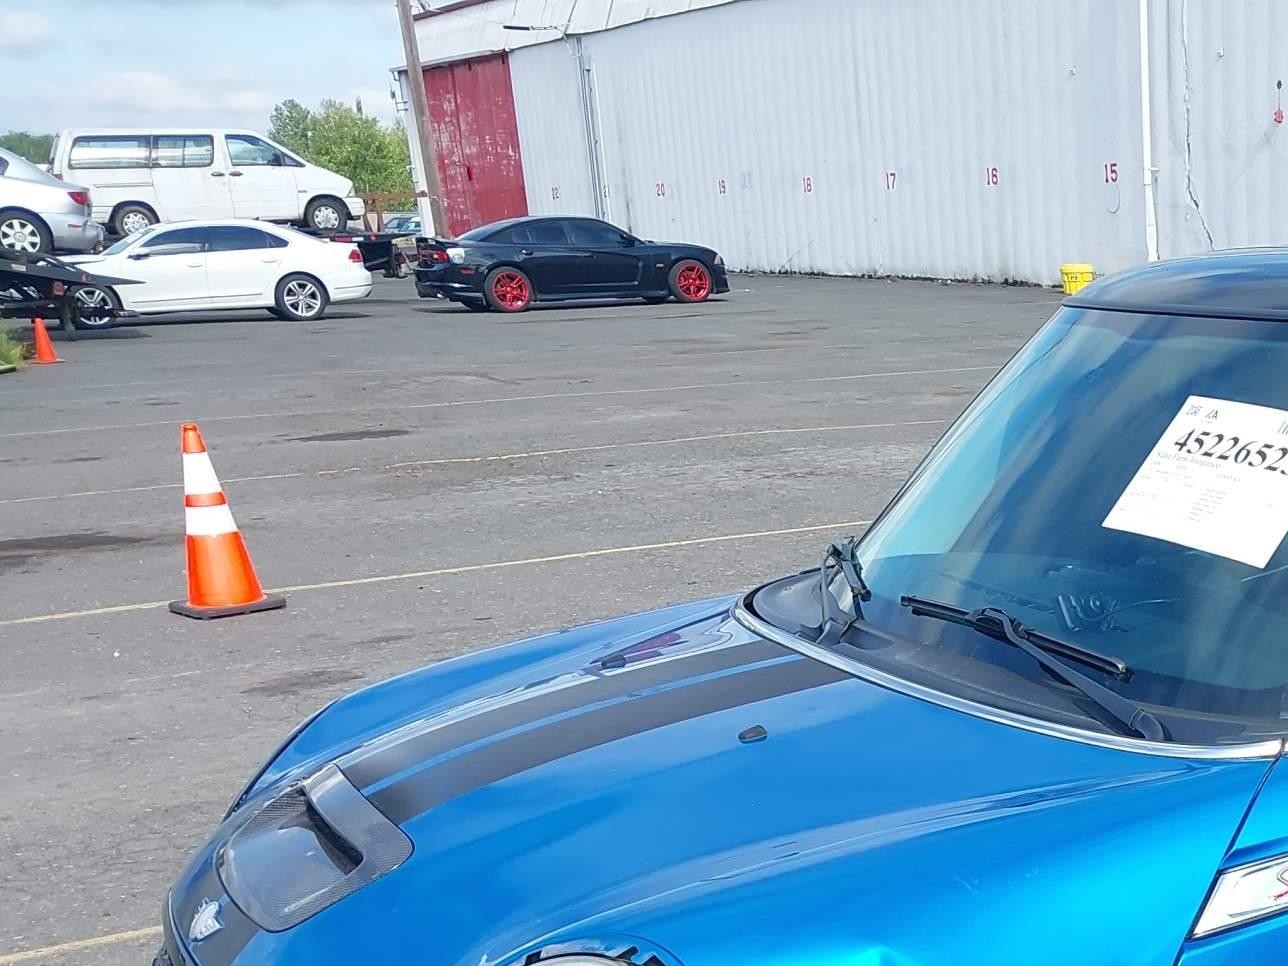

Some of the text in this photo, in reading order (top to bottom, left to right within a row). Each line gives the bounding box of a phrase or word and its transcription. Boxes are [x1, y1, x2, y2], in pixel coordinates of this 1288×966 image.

[885, 172, 897, 190] 17
[986, 167, 998, 186] 16
[1103, 162, 1119, 184] 15
[656, 183, 666, 197] 20
[718, 179, 727, 195] 19
[802, 177, 813, 193] 18
